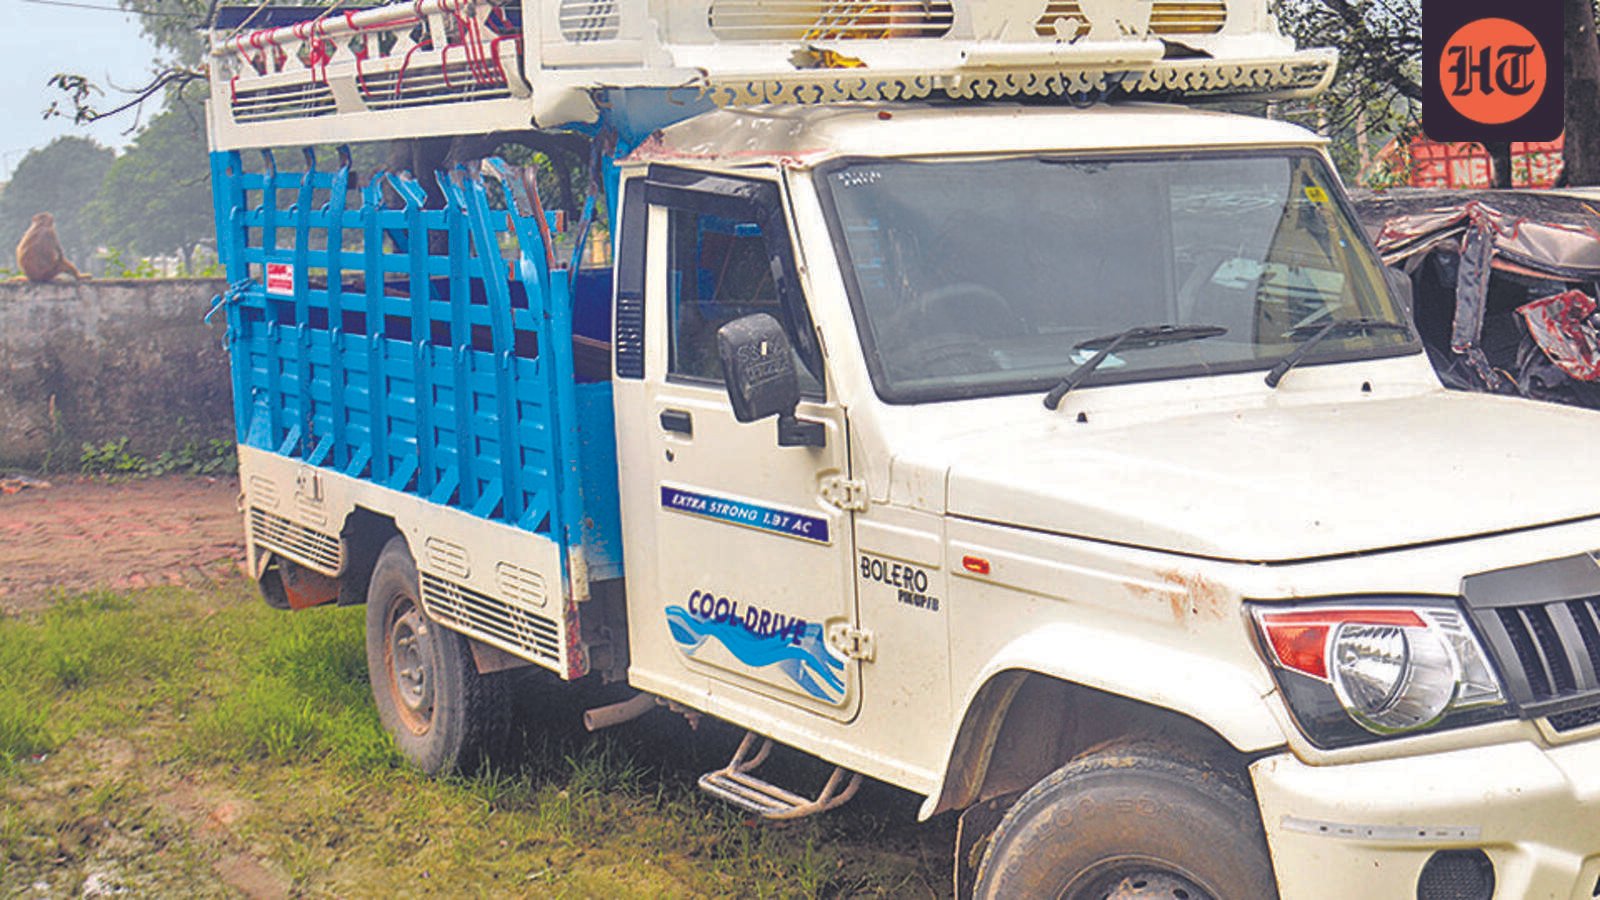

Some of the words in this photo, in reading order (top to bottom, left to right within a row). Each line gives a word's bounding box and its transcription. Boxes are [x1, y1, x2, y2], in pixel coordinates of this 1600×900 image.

[672, 493, 706, 511] EXTRA
[709, 502, 758, 521] STRONG
[792, 521, 813, 534] AC
[861, 555, 928, 593] BOLERO
